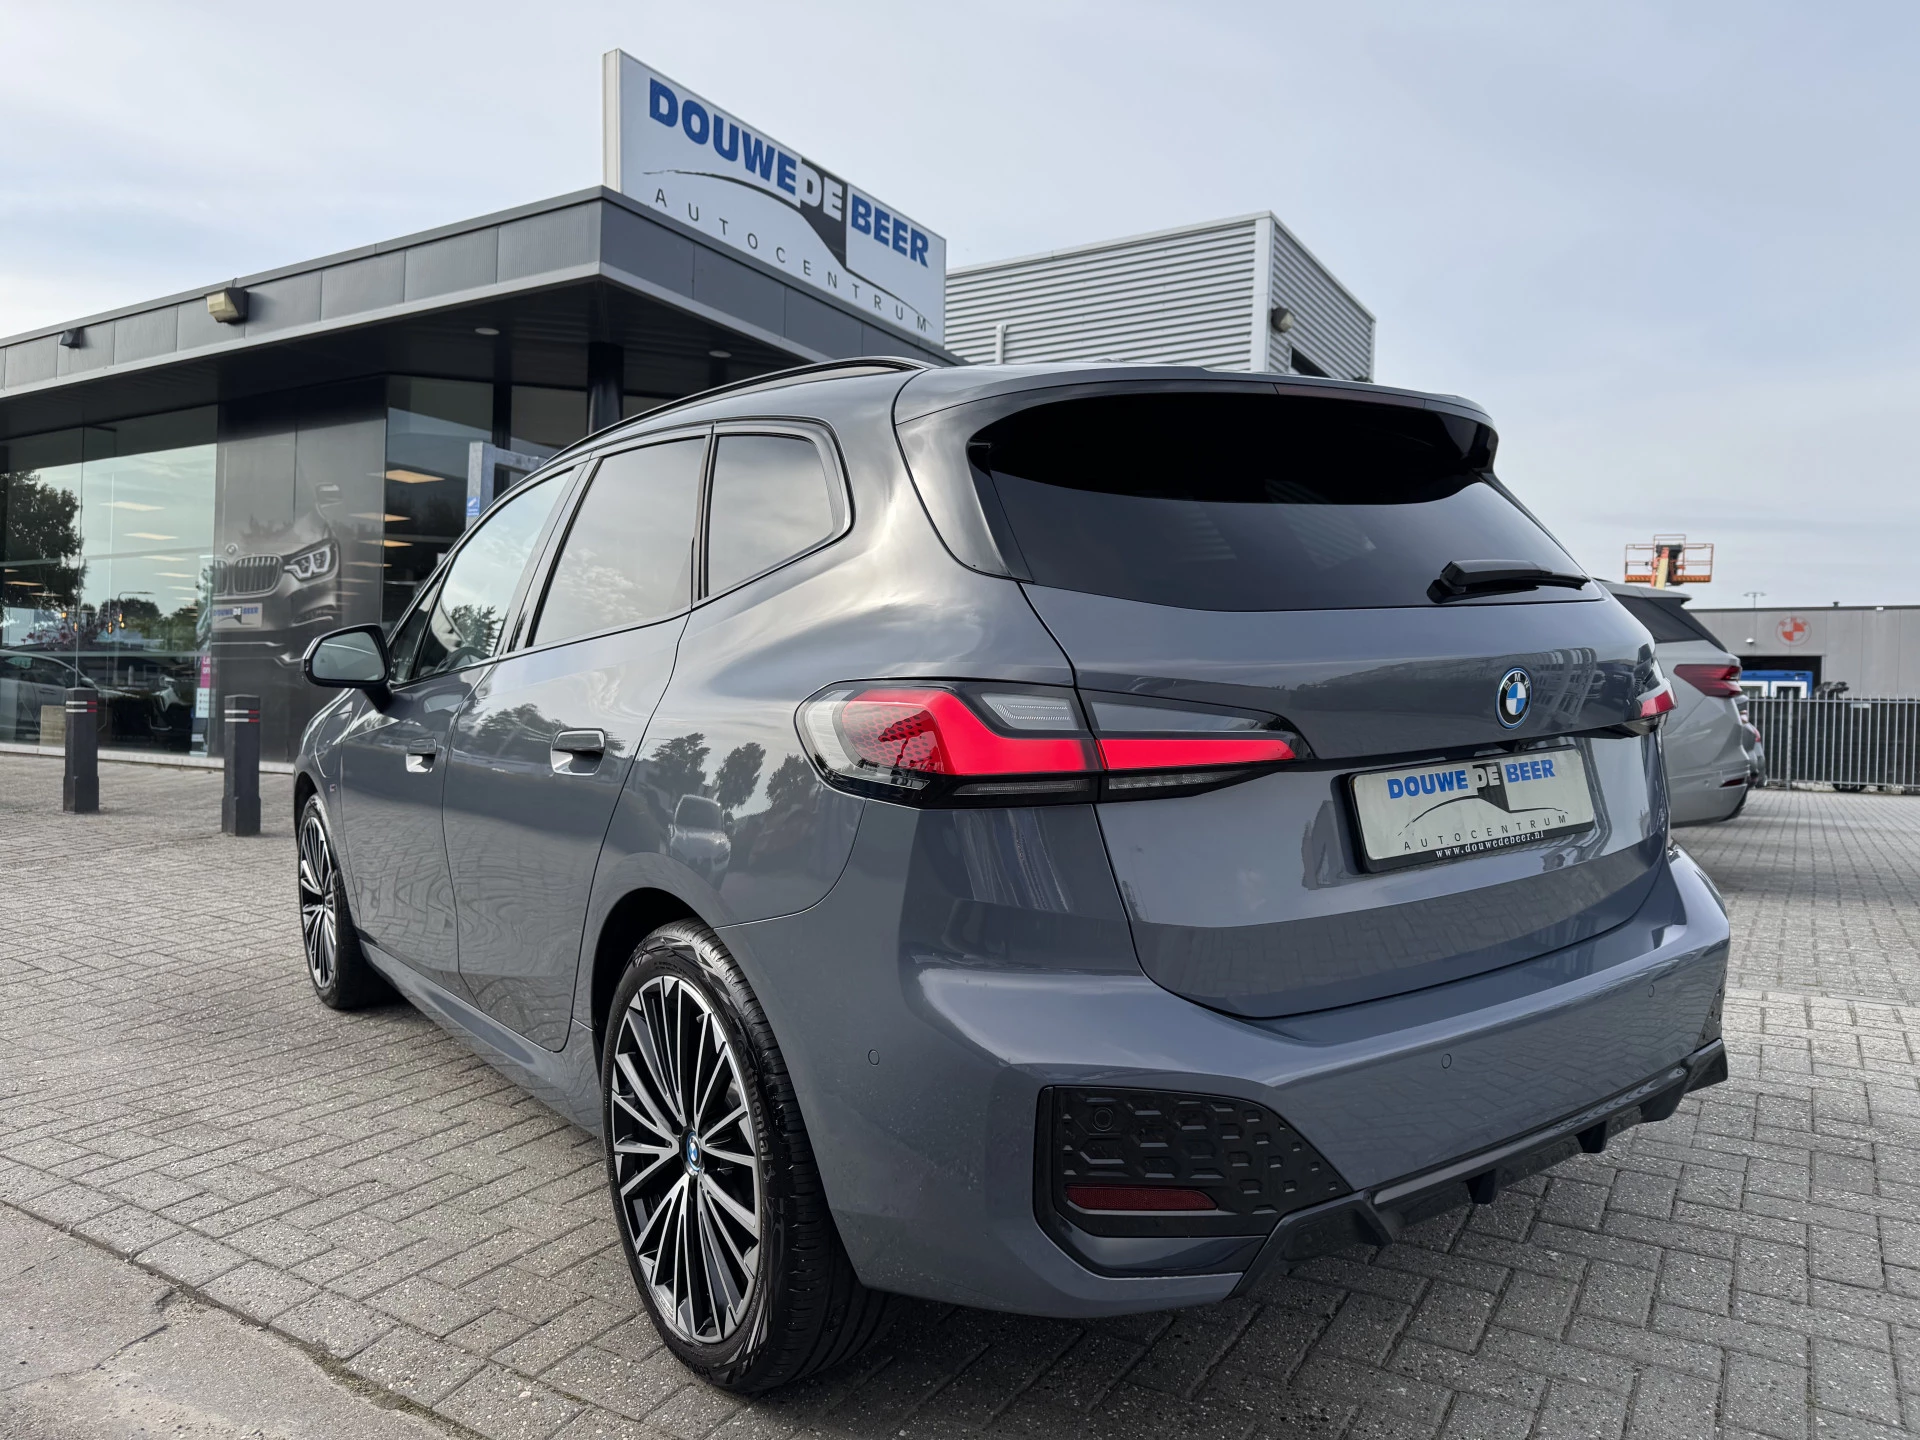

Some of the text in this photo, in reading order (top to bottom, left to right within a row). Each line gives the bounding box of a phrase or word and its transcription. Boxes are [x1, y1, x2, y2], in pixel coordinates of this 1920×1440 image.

[649, 76, 930, 269] DOUWE DE BEER
[655, 187, 928, 333] AUTOCENTRUM
[1503, 672, 1530, 690] BMW
[1386, 759, 1556, 799] DOUWE DE BEER
[1404, 814, 1567, 851] AUTOCENTRUM
[1435, 830, 1545, 859] www.douwedebeer.nl
